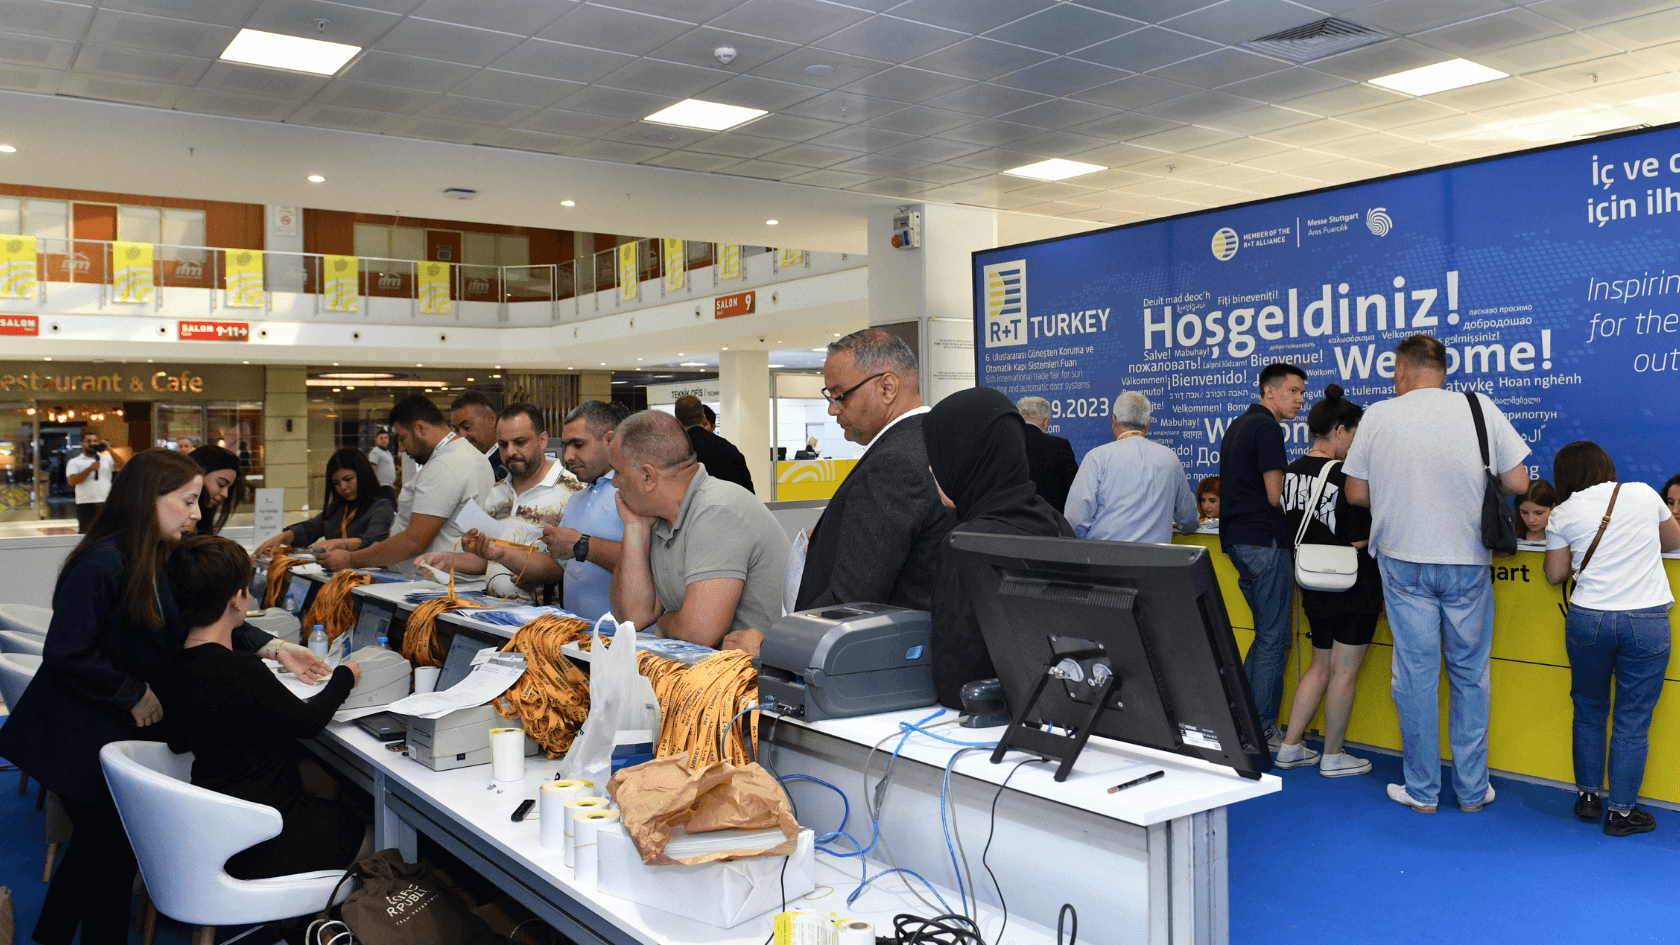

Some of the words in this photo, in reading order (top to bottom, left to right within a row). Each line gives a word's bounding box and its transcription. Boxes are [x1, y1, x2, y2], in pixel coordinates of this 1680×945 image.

[1592, 154, 1615, 190] İç
[1623, 157, 1660, 180] ve
[1587, 194, 1637, 228] için
[1646, 186, 1680, 215] ilh
[1307, 217, 1328, 227] Messe
[1328, 212, 1359, 224] Stuttgart
[1243, 230, 1268, 241] MEMBER
[1269, 229, 1277, 239] OF
[1278, 227, 1291, 235] THE
[1308, 227, 1322, 236] Ares
[1243, 239, 1254, 248] R+T
[1255, 236, 1286, 247] ALLIANCE
[716, 297, 738, 311] SALON
[745, 294, 752, 310] 9
[1143, 296, 1164, 307] Deuit
[1165, 294, 1182, 304] mad
[1143, 270, 1460, 359] Hoşgeldiniz!
[1499, 304, 1533, 315] просимо
[0, 318, 37, 328] SALON
[181, 323, 215, 333] SALON
[216, 326, 239, 337] 9-11
[990, 318, 1022, 343] R+T
[1030, 307, 1111, 339] TURKEY
[1462, 316, 1533, 331] добродошао
[1586, 312, 1627, 343] for
[1635, 308, 1679, 335] the
[985, 353, 992, 362] 6.
[1059, 347, 1084, 356] Koruma
[1085, 346, 1094, 354] ve
[1143, 349, 1172, 361] Salve!
[1174, 347, 1210, 358] Mabuhay!
[1333, 329, 1553, 380] Weome!
[985, 363, 1012, 373] Otomatik
[1028, 360, 1059, 370] Sistemleri
[1128, 356, 1201, 374] пожаловать!
[129, 375, 145, 392] &
[151, 370, 204, 393] Cafe
[1033, 371, 1049, 380] trade
[1061, 370, 1071, 378] for
[1071, 370, 1083, 378] sun
[1121, 374, 1168, 386] Välkommen!
[1167, 369, 1247, 390] ¡Bienvenido!
[1499, 376, 1531, 388] Hoan
[1534, 373, 1582, 389] nghênh
[1008, 385, 1019, 393] and
[1020, 382, 1049, 392] automatic
[1049, 381, 1063, 390] door
[1064, 380, 1091, 391] systems
[1051, 397, 1110, 419] 9.2023
[1172, 403, 1223, 413] Velkommen!
[1160, 418, 1200, 429] Mabuhay!
[690, 746, 701, 769] URKEY
